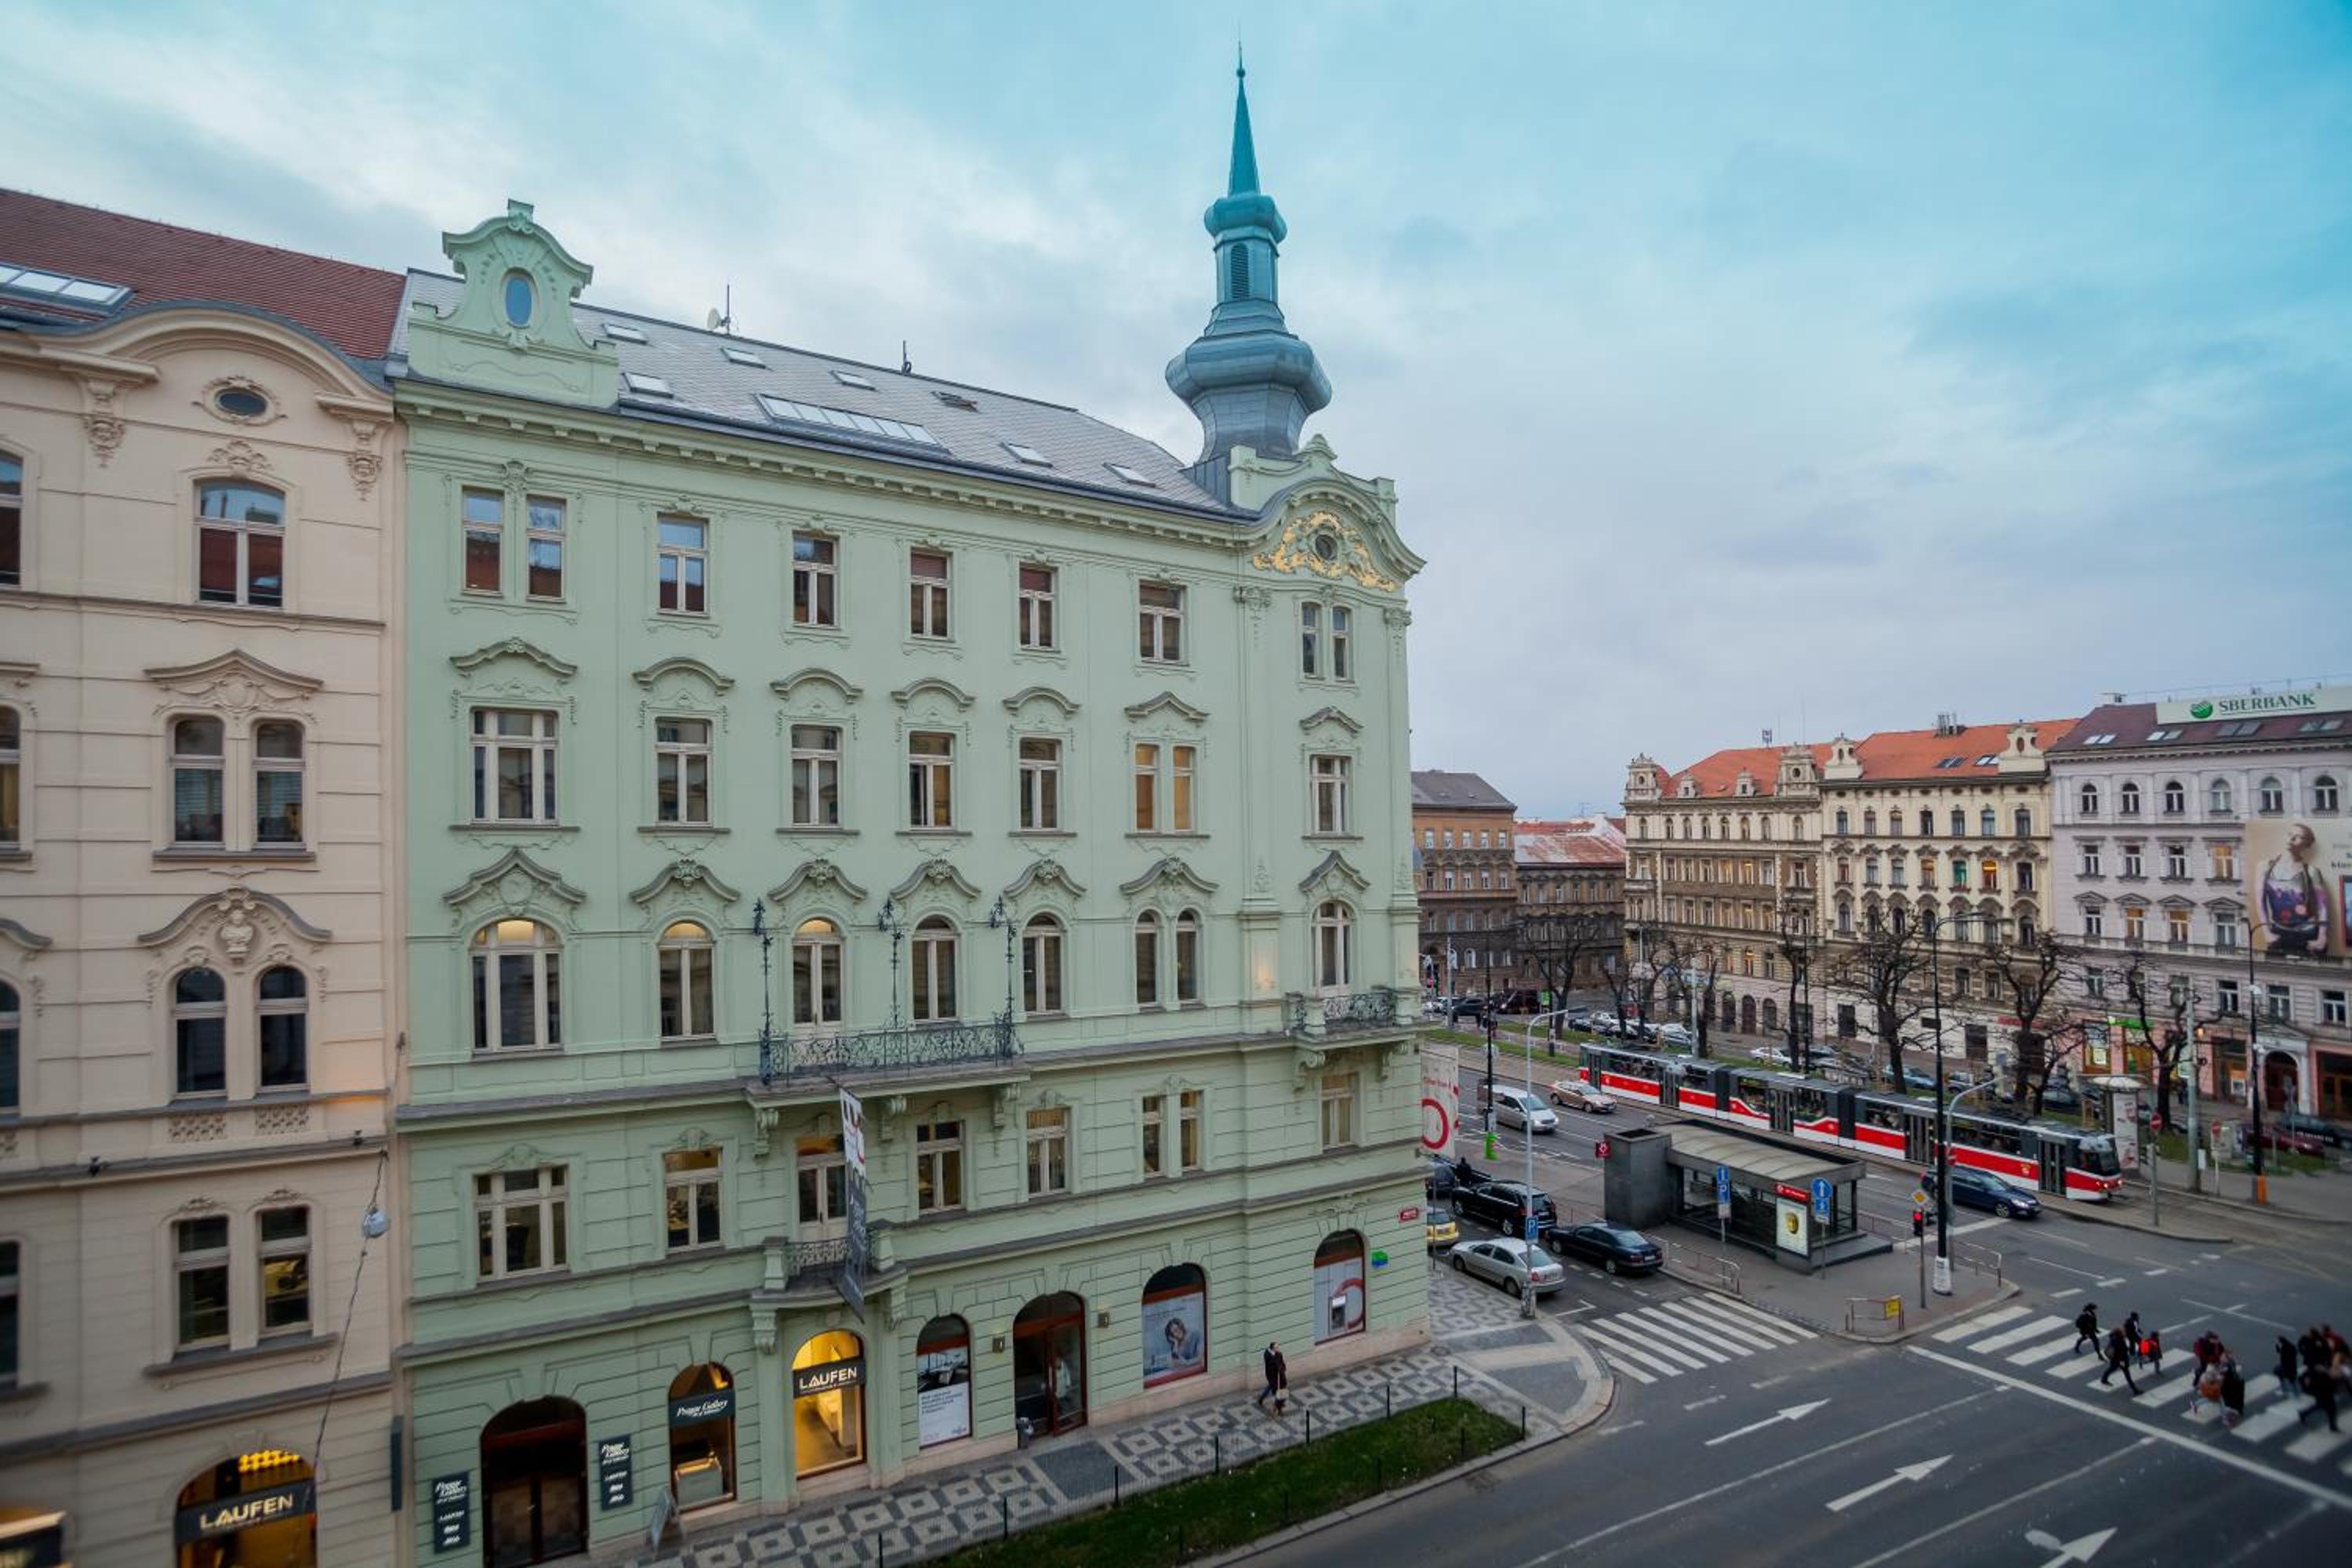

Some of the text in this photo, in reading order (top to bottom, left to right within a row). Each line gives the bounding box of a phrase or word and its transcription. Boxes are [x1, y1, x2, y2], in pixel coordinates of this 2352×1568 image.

[2219, 694, 2315, 712] SBERBANK
[1528, 1219, 1536, 1233] P
[799, 1367, 857, 1389] LAUFEN
[200, 1493, 293, 1530] LAUFEN
